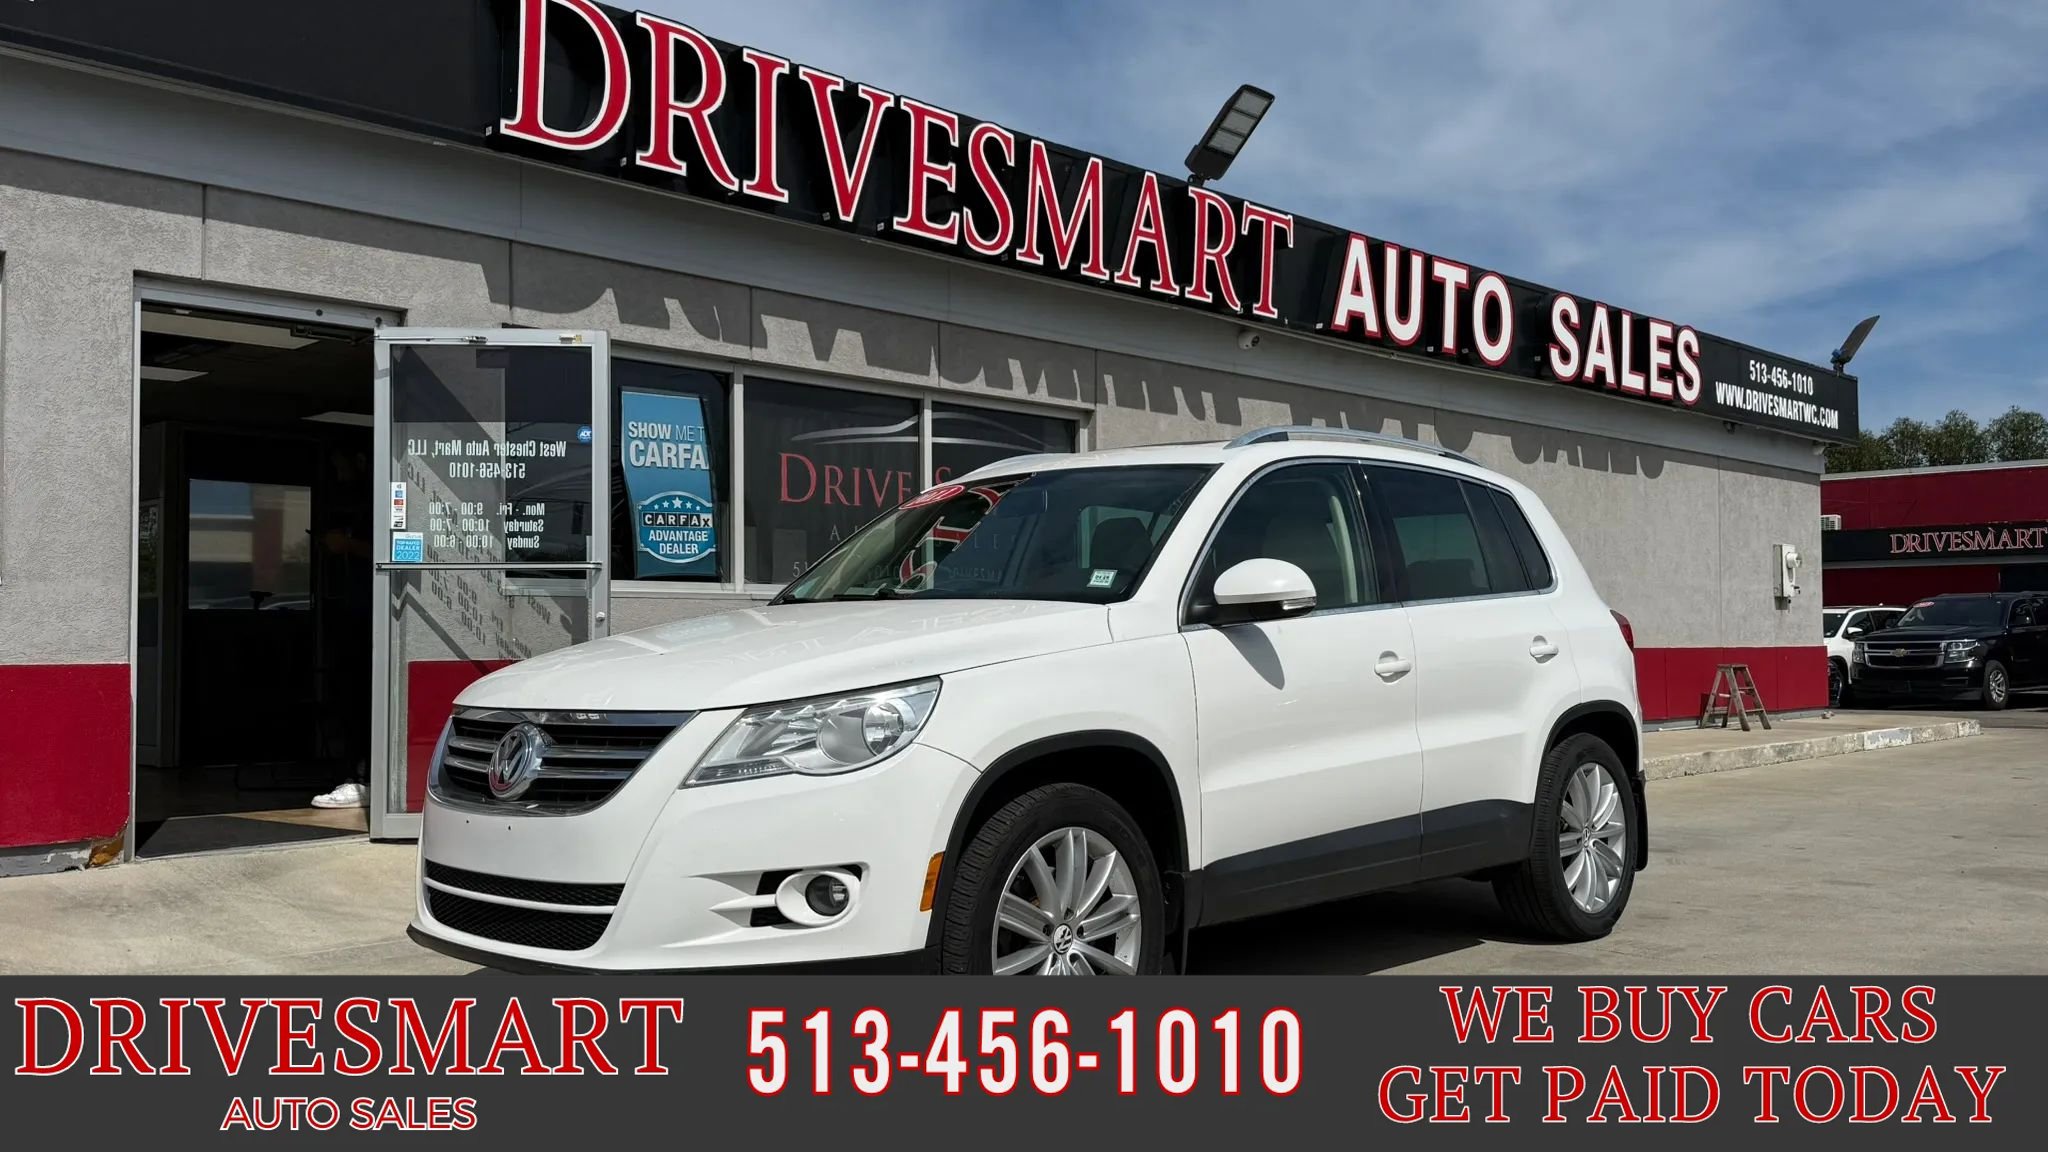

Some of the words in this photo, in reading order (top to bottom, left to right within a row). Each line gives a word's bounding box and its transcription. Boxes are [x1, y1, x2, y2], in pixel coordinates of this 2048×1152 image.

[499, 0, 1294, 320] DRIVESMART
[1332, 231, 1514, 367] AUTO
[1548, 293, 1701, 405] SALES
[1749, 360, 1814, 396] 513-456-1010
[1715, 381, 1839, 430] WWW.DRIVESMARTWC.COM
[628, 421, 672, 440] SHOW
[675, 425, 695, 442] ME
[629, 441, 710, 470] CARFA
[643, 512, 712, 528] CARFAX
[649, 530, 709, 542] ADVANTAGE
[659, 543, 699, 555] DEALER
[1889, 526, 2048, 554] DRIVESMART
[396, 551, 420, 560] 2022
